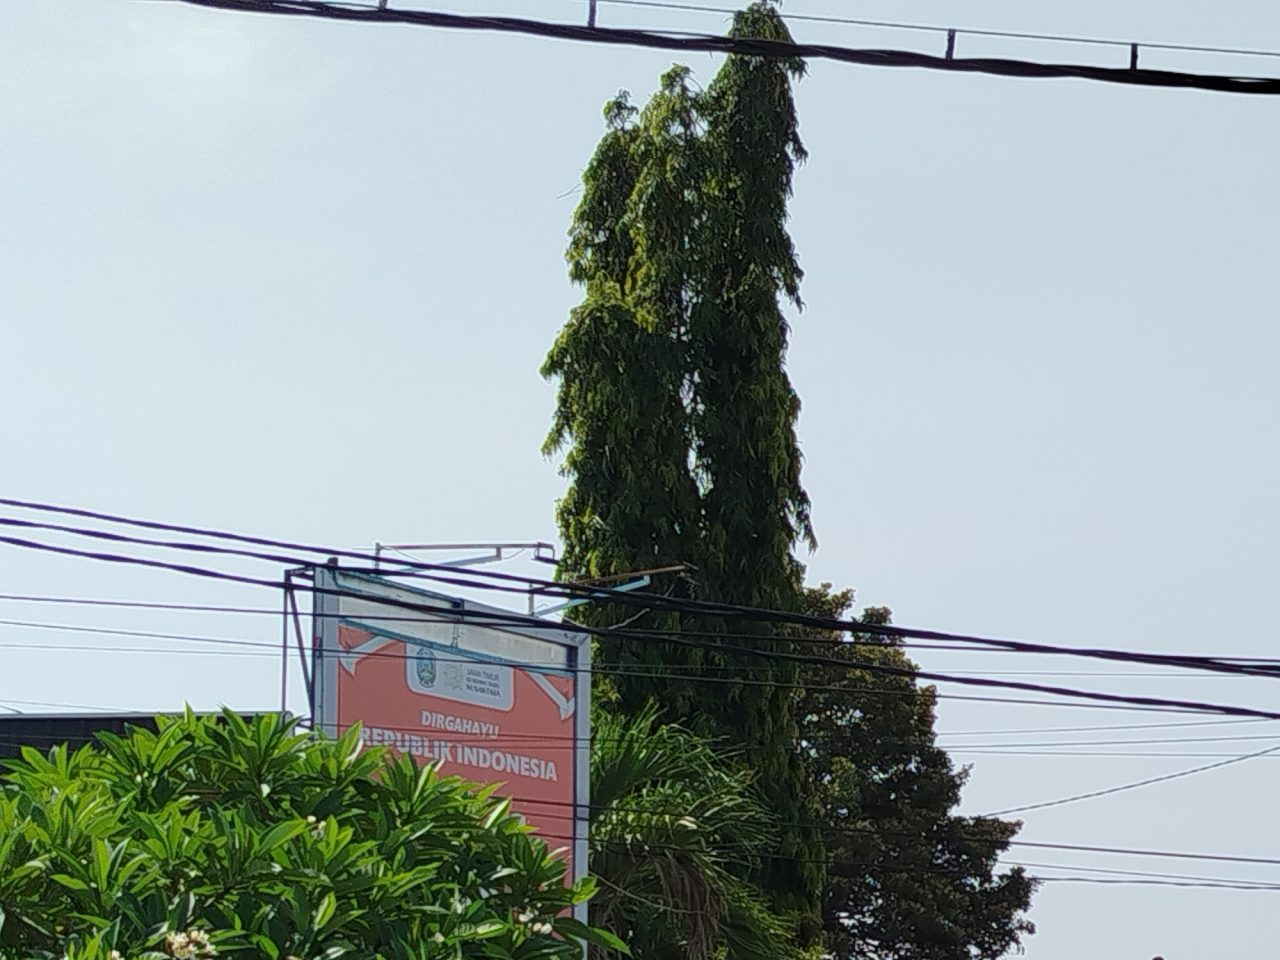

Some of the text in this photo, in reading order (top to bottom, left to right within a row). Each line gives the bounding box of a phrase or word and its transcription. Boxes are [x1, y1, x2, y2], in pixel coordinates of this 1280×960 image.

[421, 711, 499, 739] DIRGAHAYU
[360, 728, 558, 781] REPUBLIK INDONESIA
